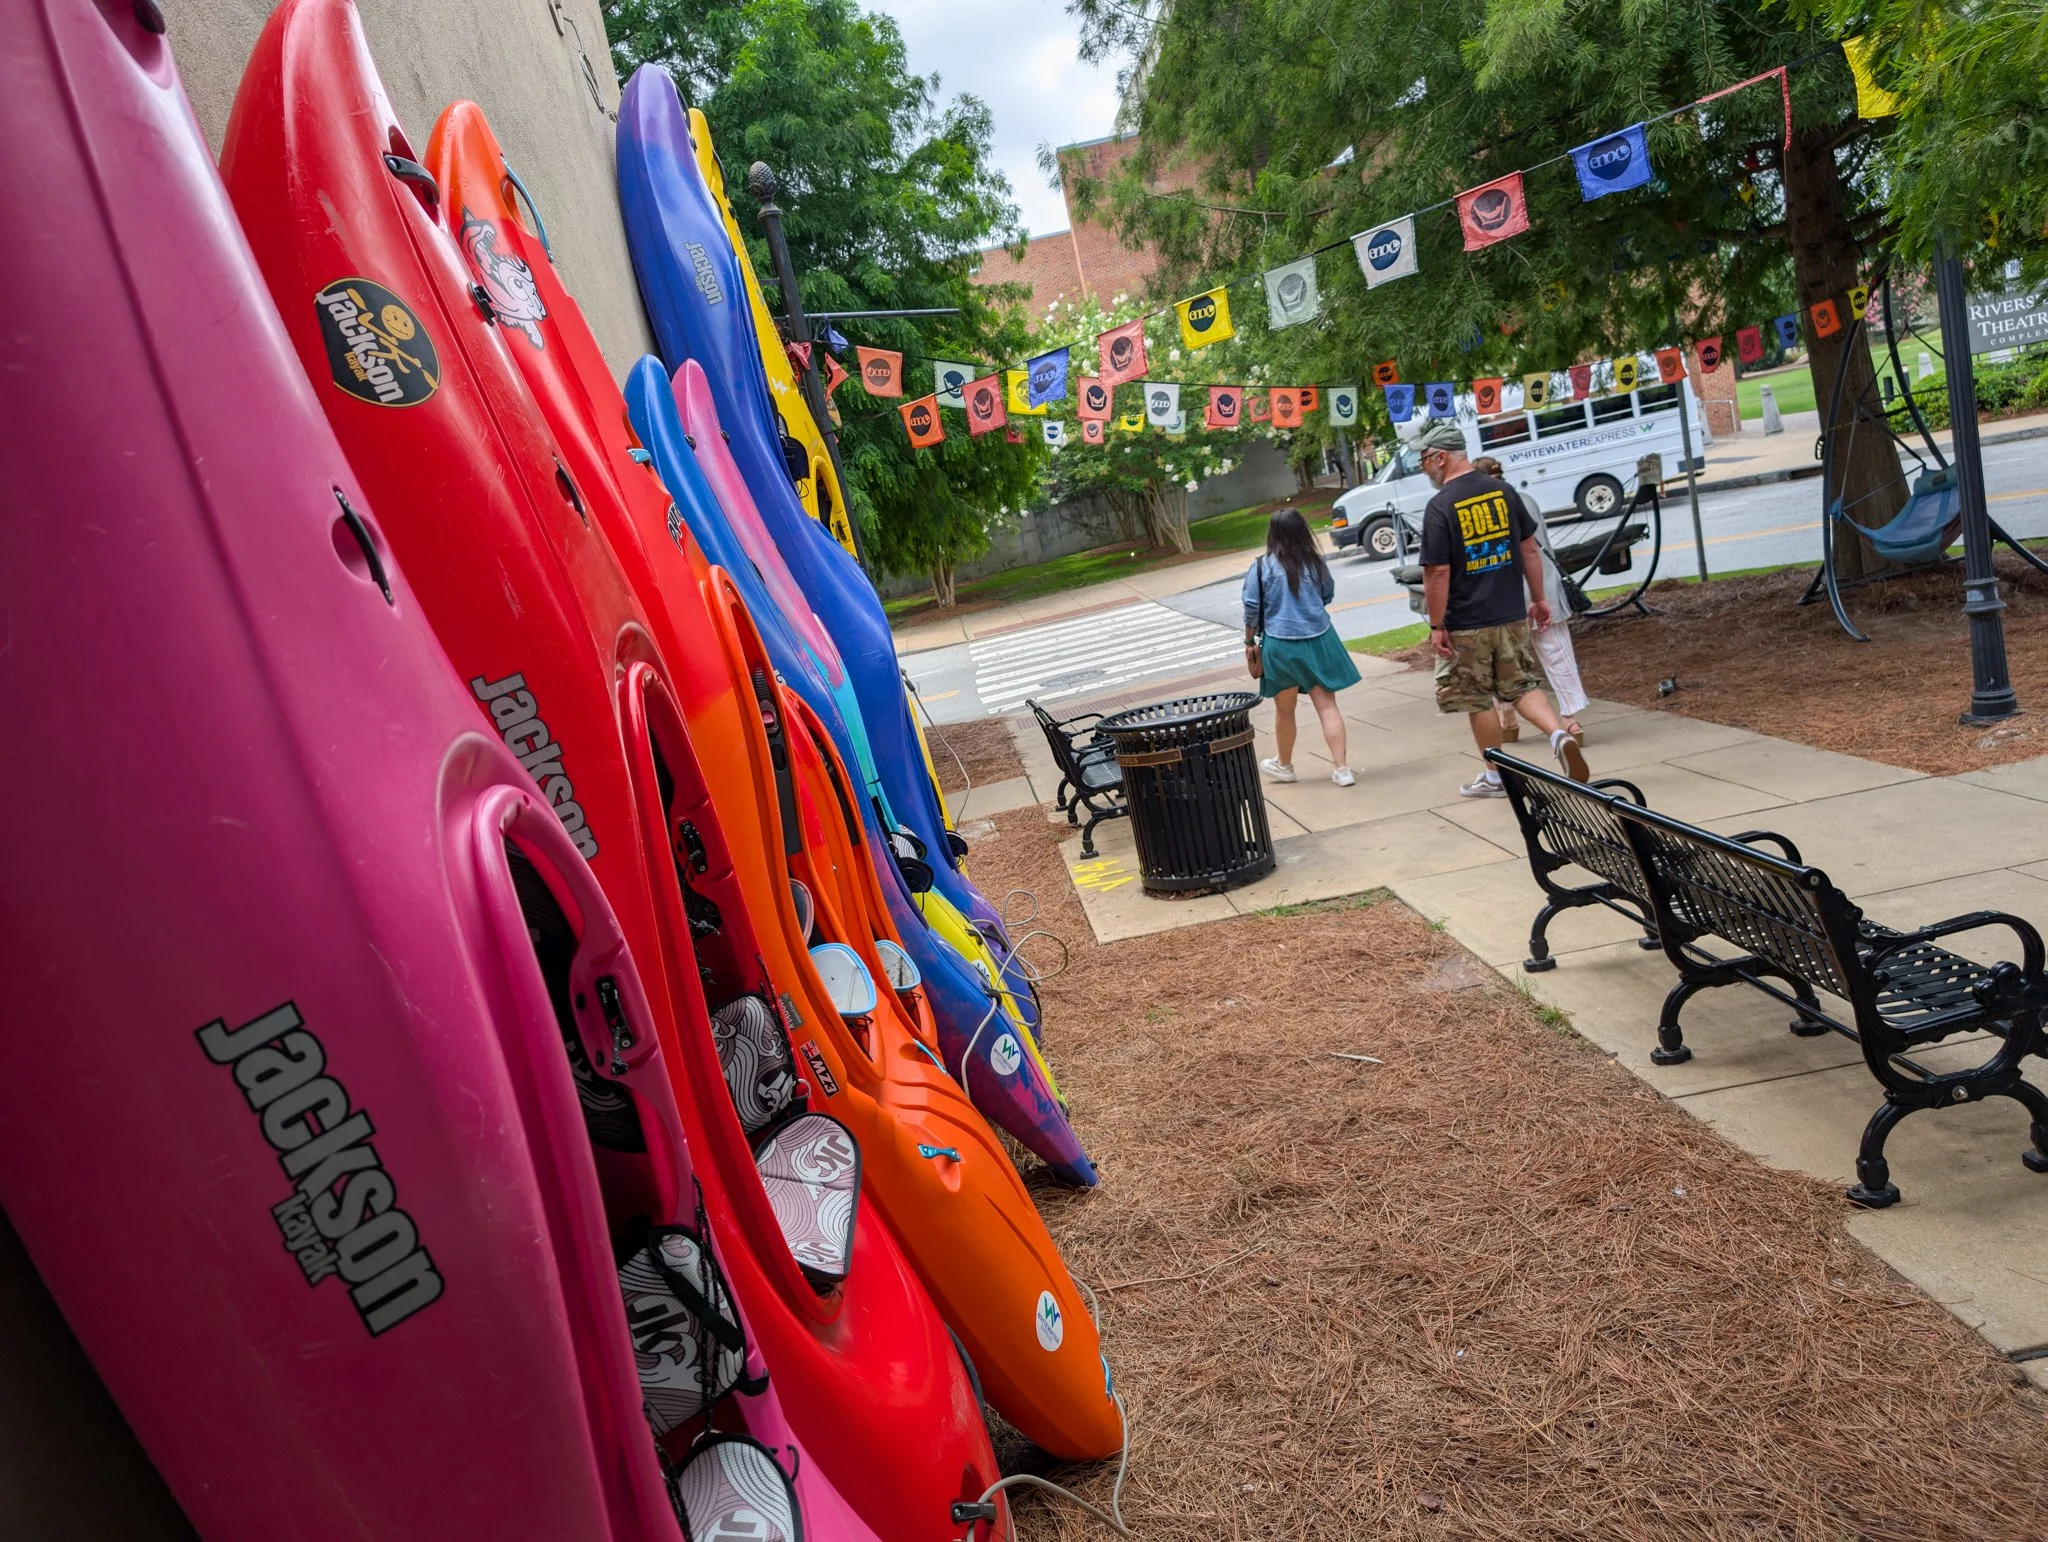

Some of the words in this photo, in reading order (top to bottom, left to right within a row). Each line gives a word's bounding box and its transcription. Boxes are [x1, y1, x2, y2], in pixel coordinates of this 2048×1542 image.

[684, 241, 723, 305] Jackson
[1969, 293, 2048, 320] RIVERS
[316, 291, 404, 403] Jackson
[344, 351, 368, 382] kayak
[1457, 497, 1509, 540] BOLD
[812, 1058, 838, 1095] MZ3
[193, 999, 445, 1339] Jackson
[270, 1189, 342, 1289] kayak
